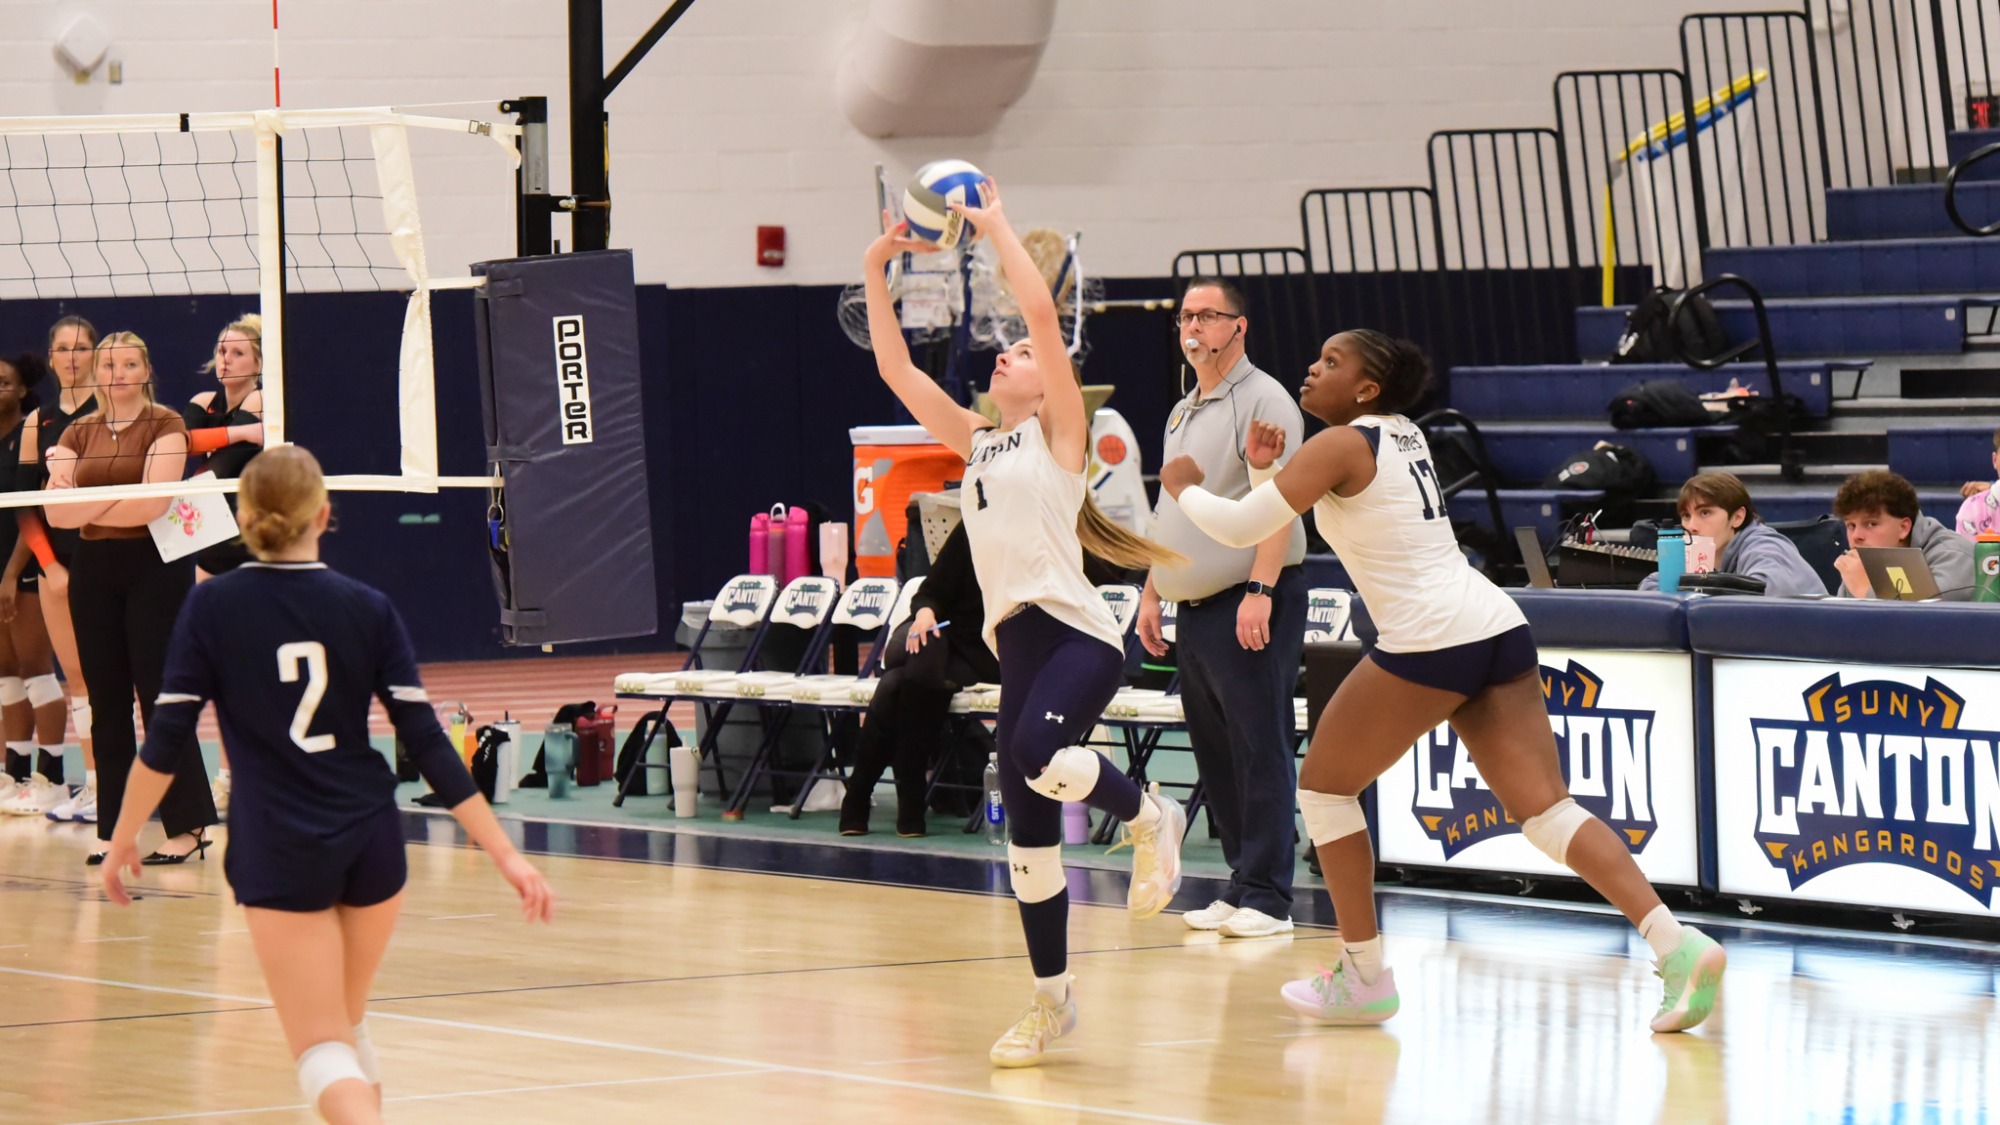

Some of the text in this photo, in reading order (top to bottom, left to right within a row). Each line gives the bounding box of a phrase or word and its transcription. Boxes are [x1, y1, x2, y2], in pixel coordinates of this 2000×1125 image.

[557, 319, 588, 440] PORTER
[854, 466, 873, 514] G
[975, 477, 987, 511] 1
[1409, 459, 1447, 520] 17
[1983, 555, 2000, 575] G
[276, 641, 336, 753] 2
[1834, 689, 1934, 727] SUNY
[1756, 727, 2000, 851] CANTON
[1791, 829, 1984, 890] KANGAROOS
